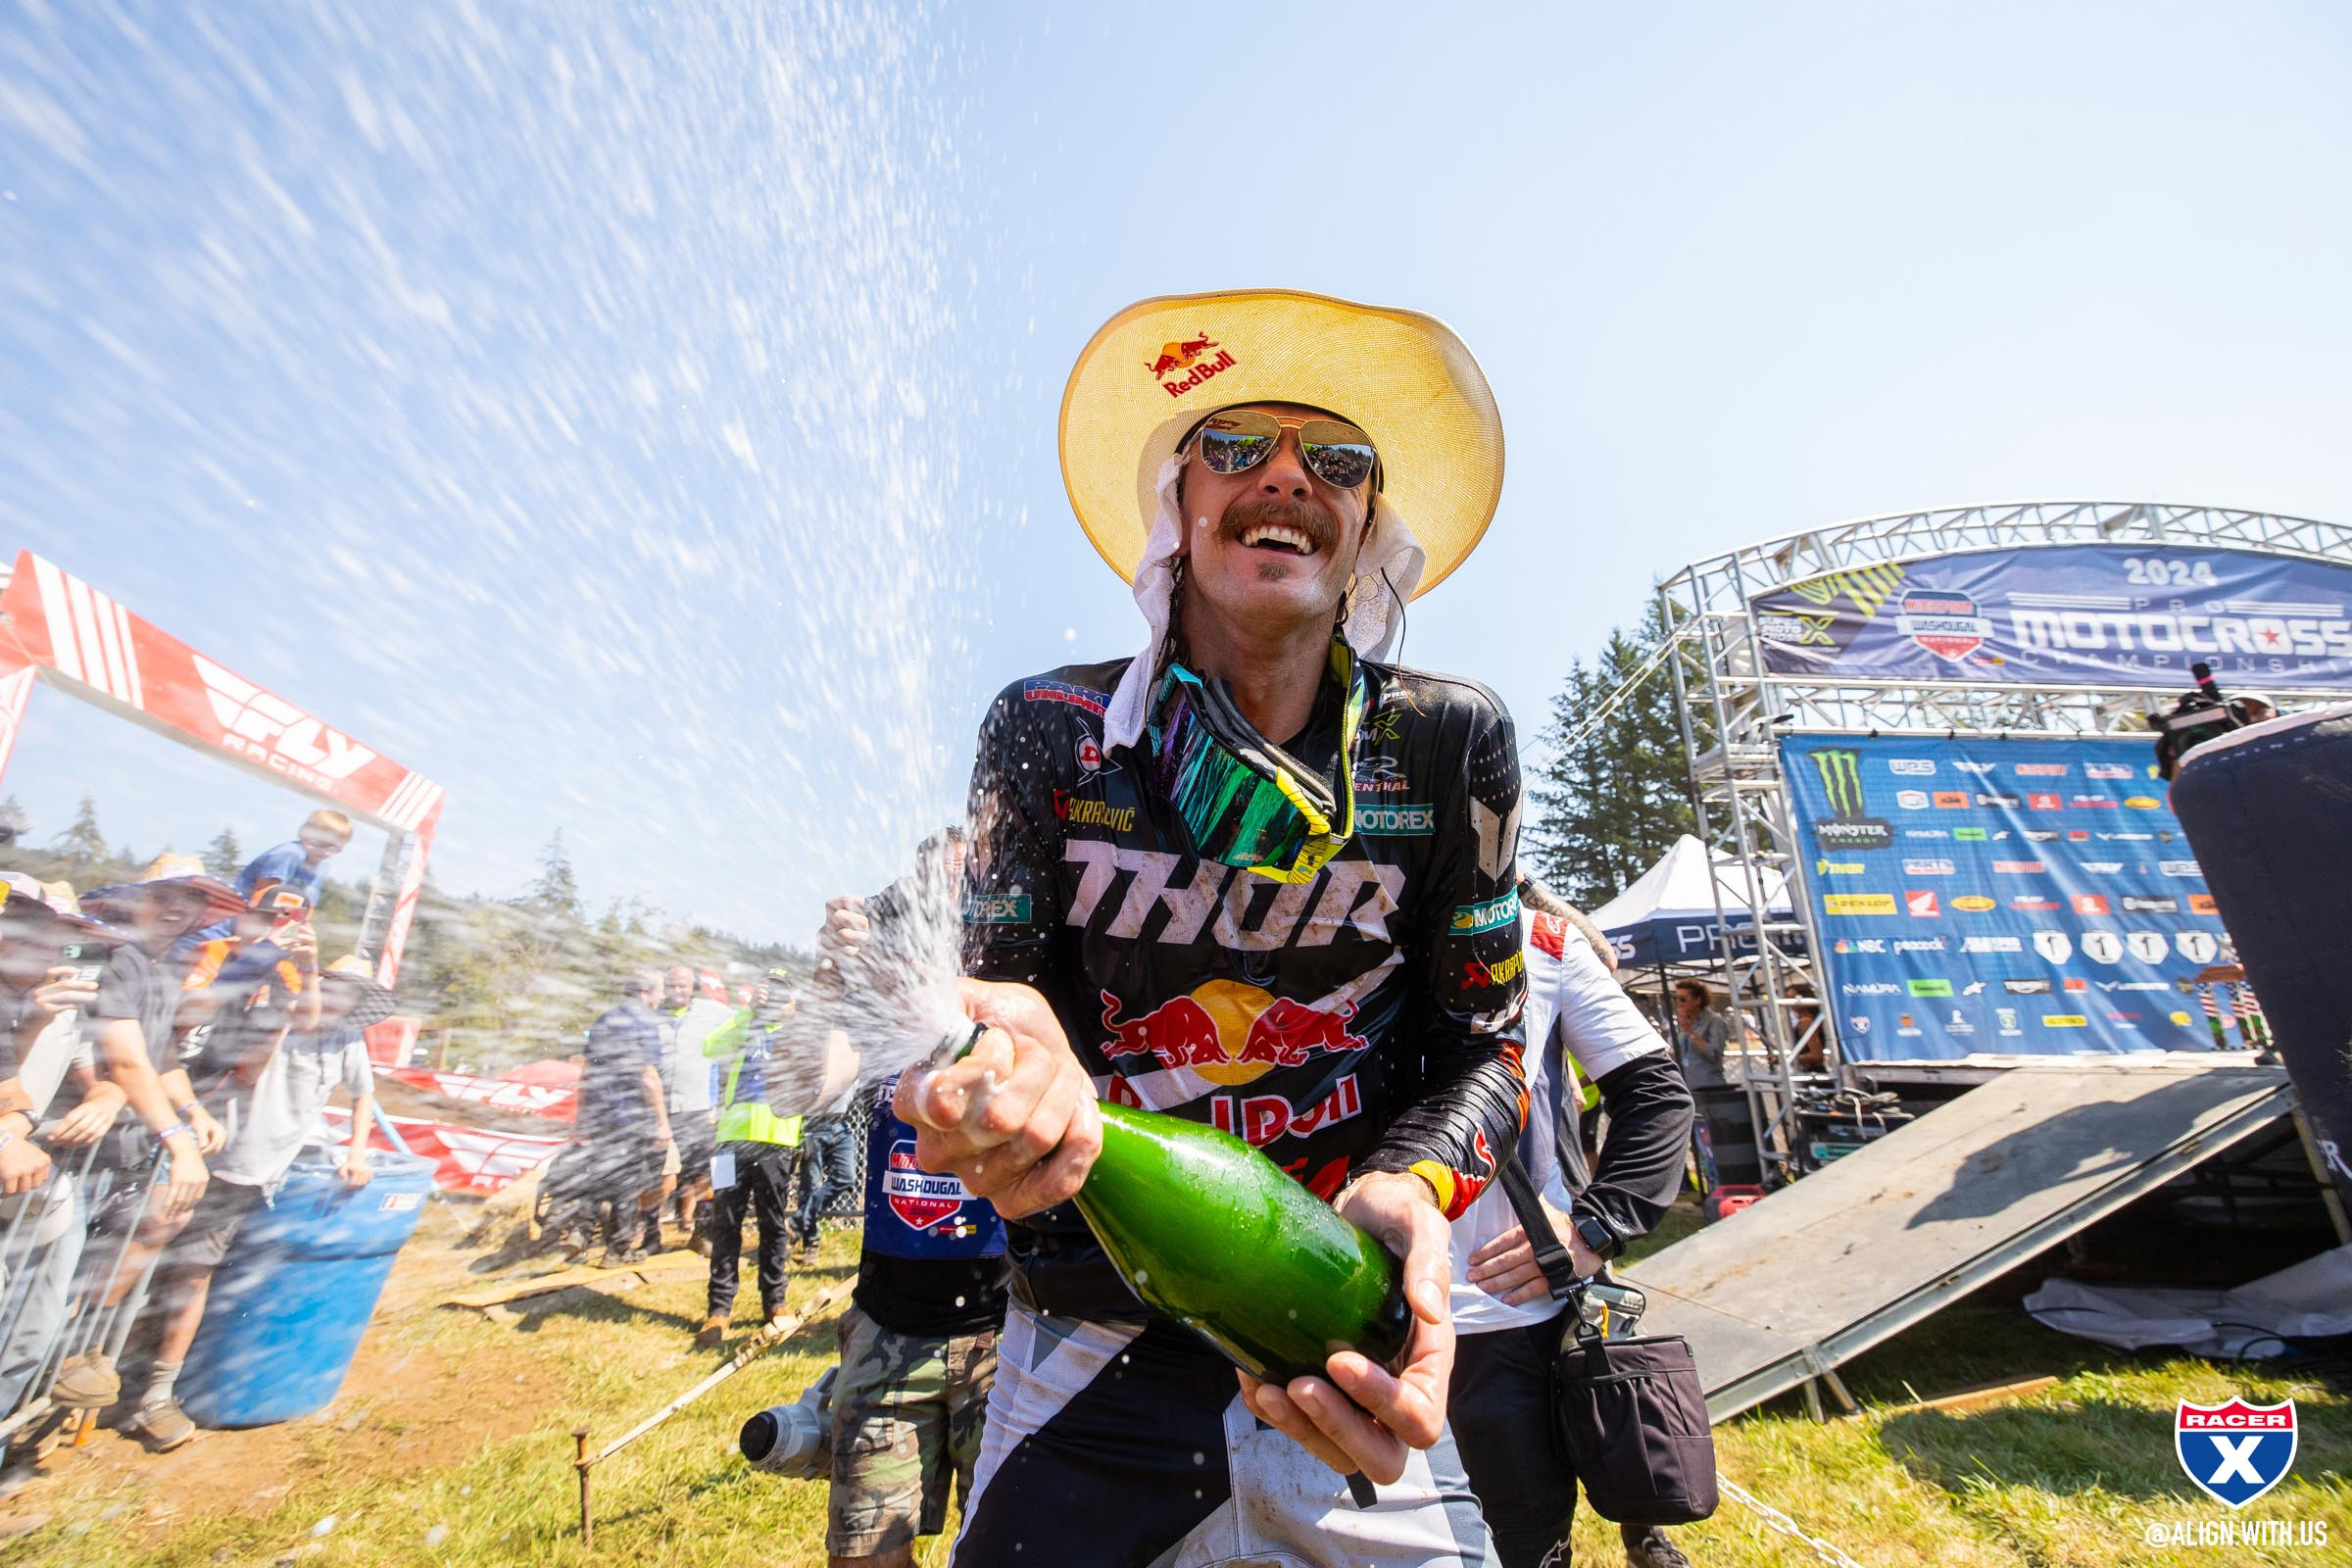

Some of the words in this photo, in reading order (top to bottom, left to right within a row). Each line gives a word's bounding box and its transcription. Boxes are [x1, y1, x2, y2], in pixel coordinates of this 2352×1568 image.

[2123, 558, 2219, 586] 2024
[2134, 597, 2226, 613] PRO
[2009, 610, 2352, 657] MOTOCROSS
[2020, 650, 2352, 676] CHAMPIONSHI
[192, 654, 378, 780] FLY
[222, 733, 336, 792] RACING
[1353, 781, 1411, 793] ENTHAL
[1819, 824, 1887, 836] MONSTER
[1064, 838, 1406, 952] THOR
[1857, 939, 1886, 953] NBC
[891, 1176, 961, 1196] WASHOUGAL
[894, 1198, 953, 1208] NATIONAL
